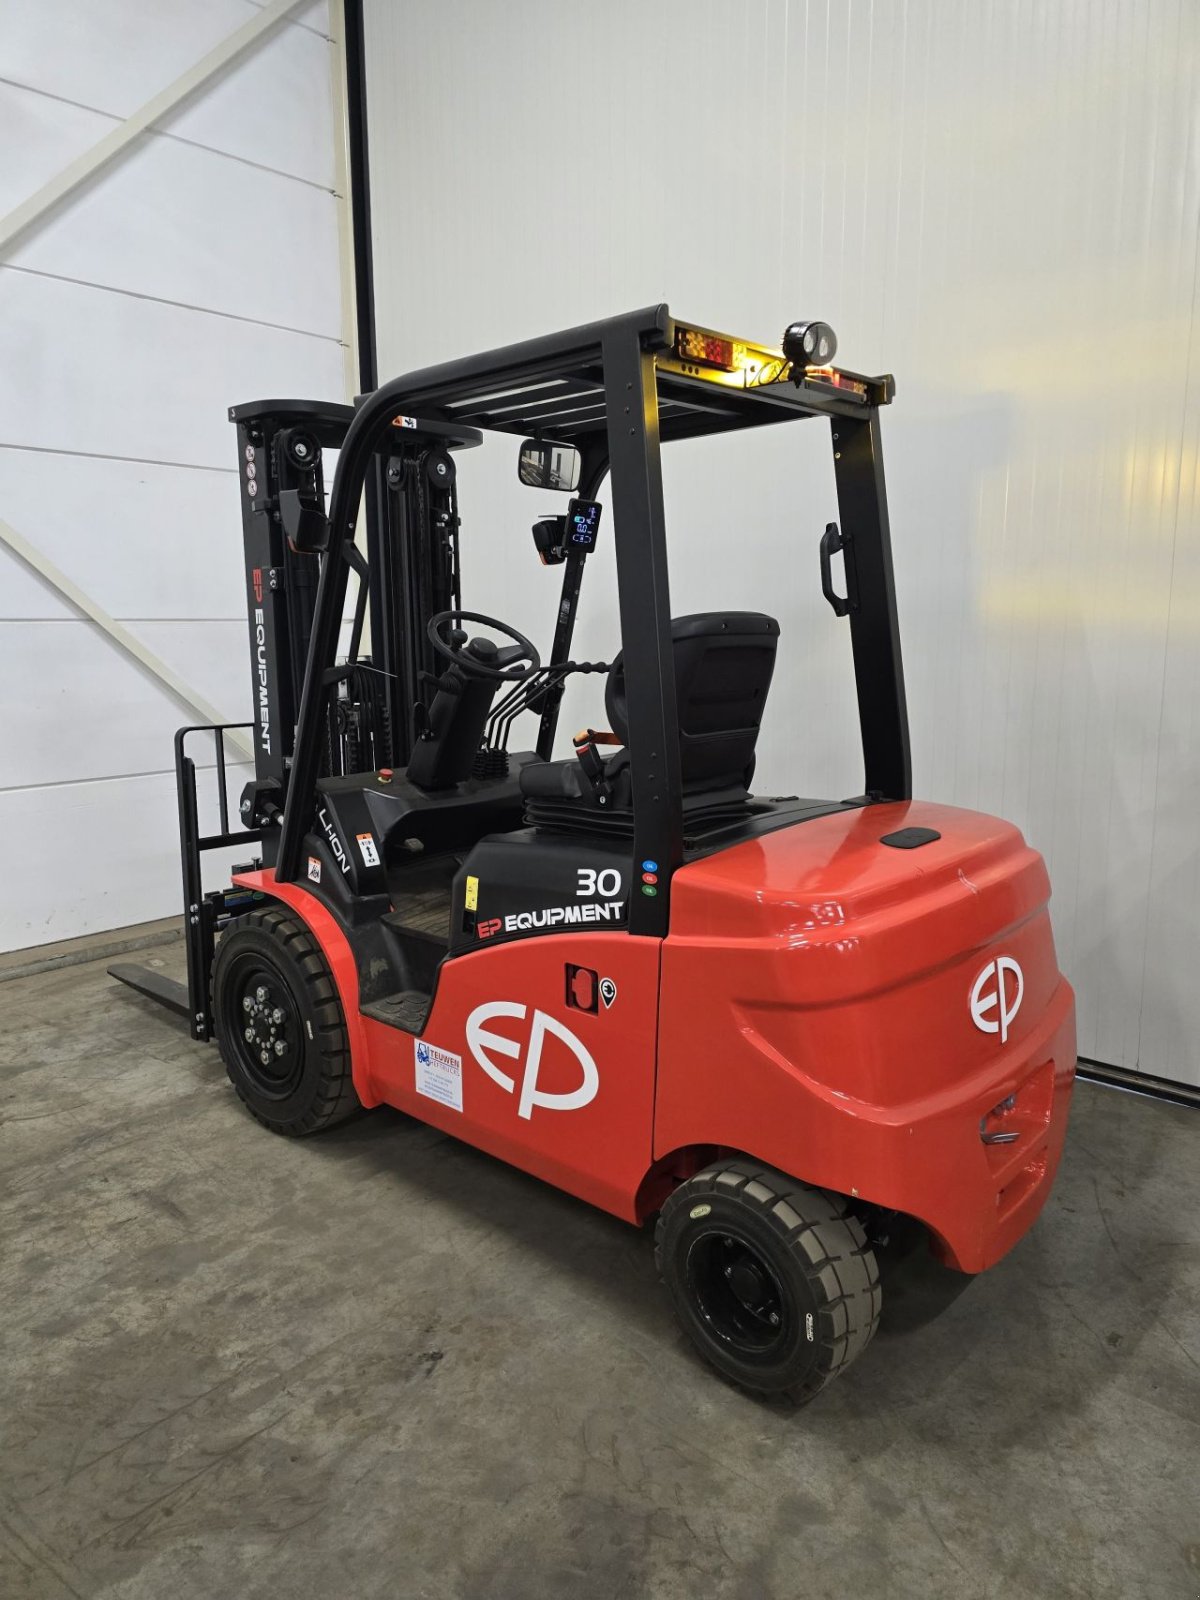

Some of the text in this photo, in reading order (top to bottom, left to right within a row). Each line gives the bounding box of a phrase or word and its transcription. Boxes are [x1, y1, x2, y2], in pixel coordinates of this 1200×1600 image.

[251, 568, 273, 755] EP EQUIPMENT
[576, 869, 622, 897] 30
[477, 901, 624, 939] EP EQUIPMENT
[970, 956, 1024, 1043] EP
[430, 1050, 460, 1068] TEUWEN
[465, 1001, 599, 1120] EP
